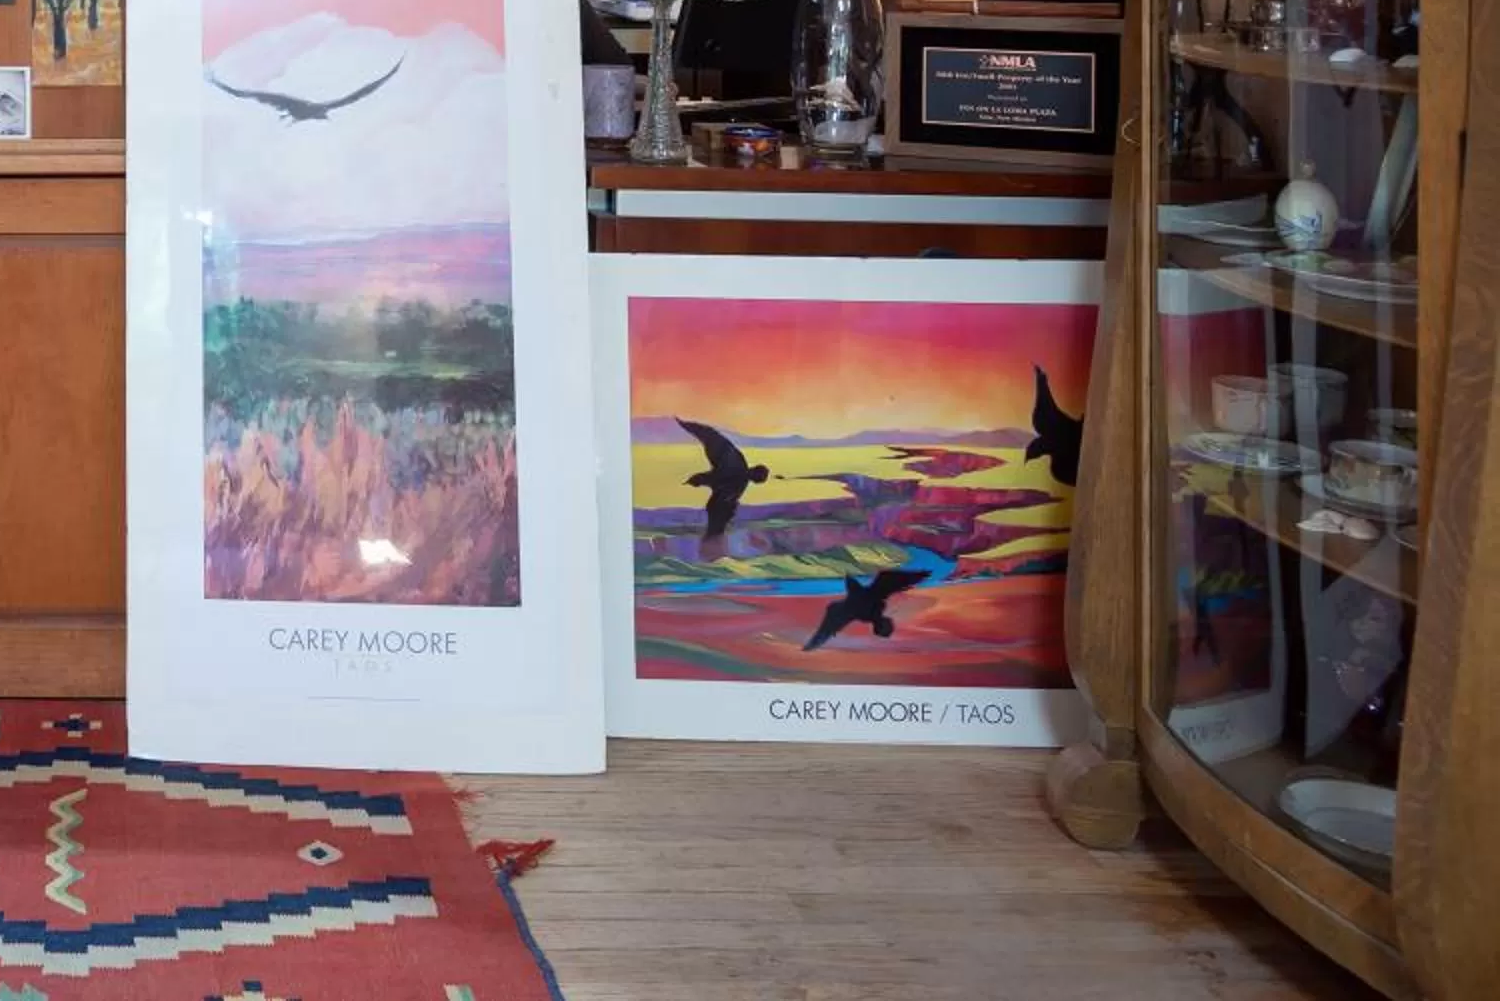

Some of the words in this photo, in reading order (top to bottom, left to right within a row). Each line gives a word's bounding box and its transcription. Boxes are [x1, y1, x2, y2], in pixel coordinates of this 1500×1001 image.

[990, 55, 1036, 68] NMLA
[269, 628, 348, 650] CAREY
[358, 630, 457, 655] MOORE
[769, 699, 841, 720] CAREY
[850, 701, 932, 723] MOORE
[956, 704, 1015, 725] TAOS
